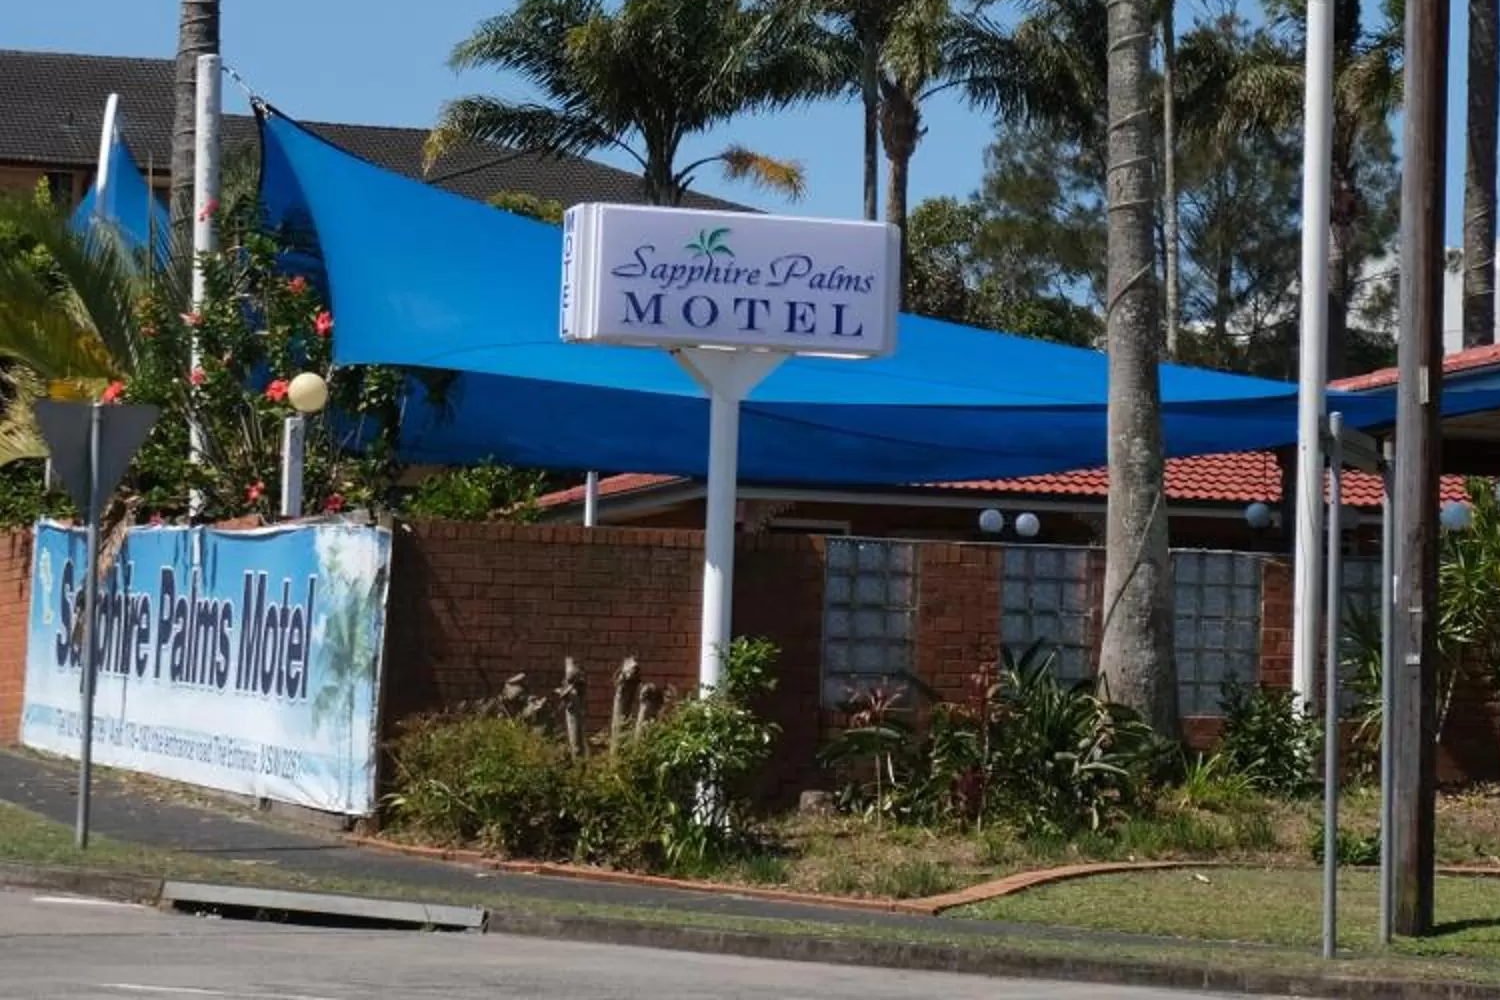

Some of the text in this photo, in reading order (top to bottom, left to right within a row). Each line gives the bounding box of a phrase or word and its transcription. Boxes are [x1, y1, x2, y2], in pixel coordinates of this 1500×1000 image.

[562, 209, 576, 336] MOTEL
[611, 245, 875, 294] Sapphire Palms
[621, 290, 864, 338] MOTEL
[56, 559, 316, 699] Saphire Palms Motel
